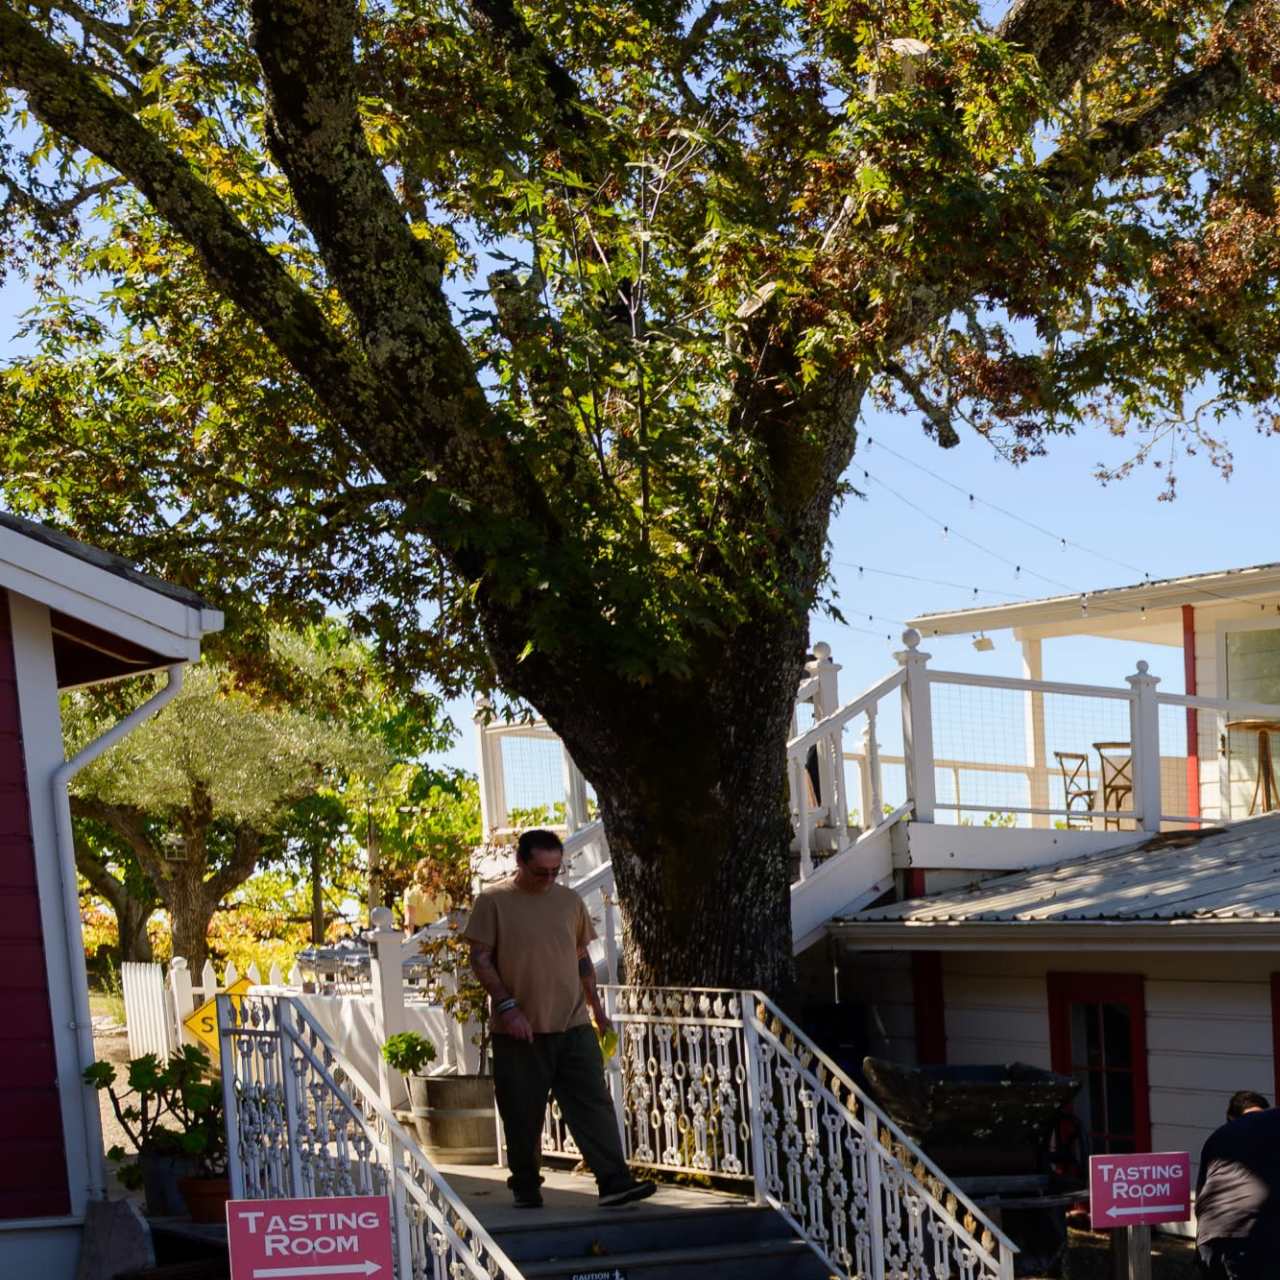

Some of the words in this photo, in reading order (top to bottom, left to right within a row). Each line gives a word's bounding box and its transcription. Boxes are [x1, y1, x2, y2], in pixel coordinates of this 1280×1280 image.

[1097, 1164, 1184, 1182] TASTING
[1112, 1181, 1170, 1199] ROOM
[238, 1211, 380, 1233] TASTING
[265, 1234, 359, 1256] ROOM
[572, 1272, 610, 1280] CAUTION
